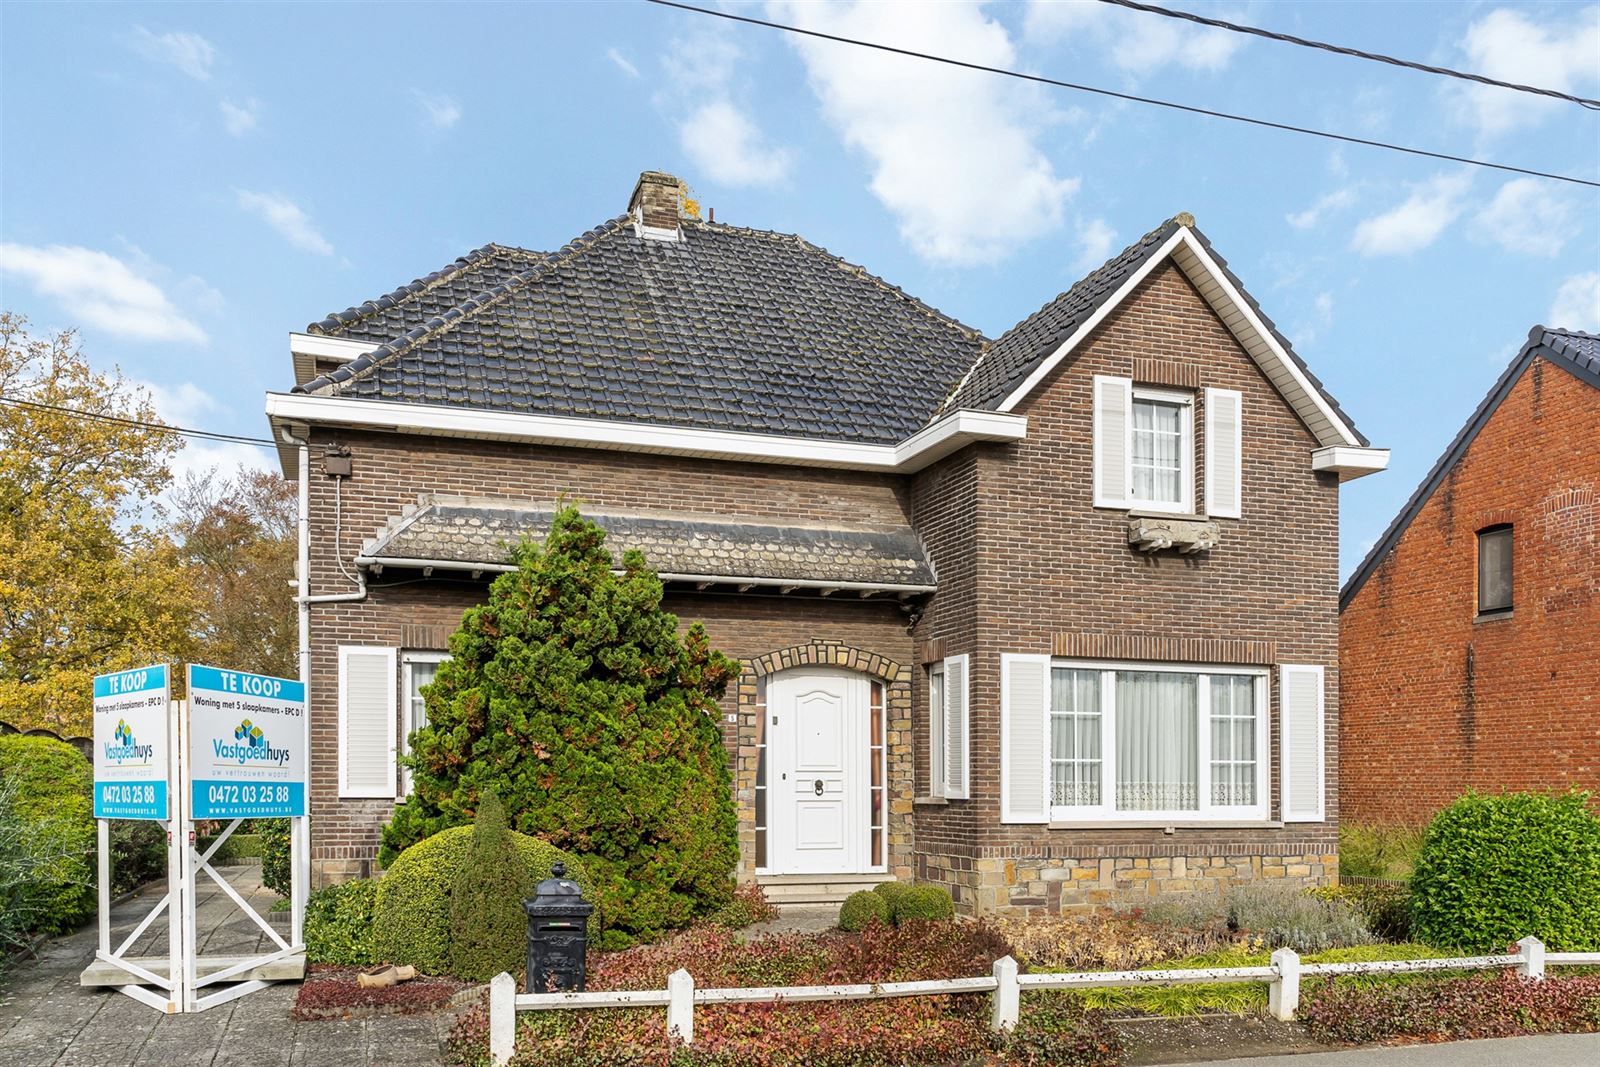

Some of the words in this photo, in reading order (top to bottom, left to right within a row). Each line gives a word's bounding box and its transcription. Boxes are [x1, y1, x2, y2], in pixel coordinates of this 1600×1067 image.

[109, 676, 119, 694] TE
[121, 671, 147, 692] KOOP
[220, 672, 237, 692] TE
[242, 675, 281, 697] KOOP
[95, 704, 109, 714] Woning
[148, 697, 156, 707] EPC
[157, 696, 162, 706] D
[194, 696, 220, 709] Woning
[222, 701, 235, 709] met
[236, 701, 240, 710] 5
[242, 702, 280, 714] slaapkamers
[284, 707, 294, 716] EPC
[296, 708, 300, 716] D
[104, 738, 153, 764] Vastgoedhuys
[213, 739, 290, 766] Vastgoedhuys
[103, 786, 120, 803] 0472
[121, 786, 132, 803] 03
[132, 786, 142, 803] 25
[144, 786, 154, 804] 88
[209, 786, 238, 803] 0472
[242, 786, 256, 803] 03
[260, 786, 274, 803] 25
[276, 786, 289, 802] 88
